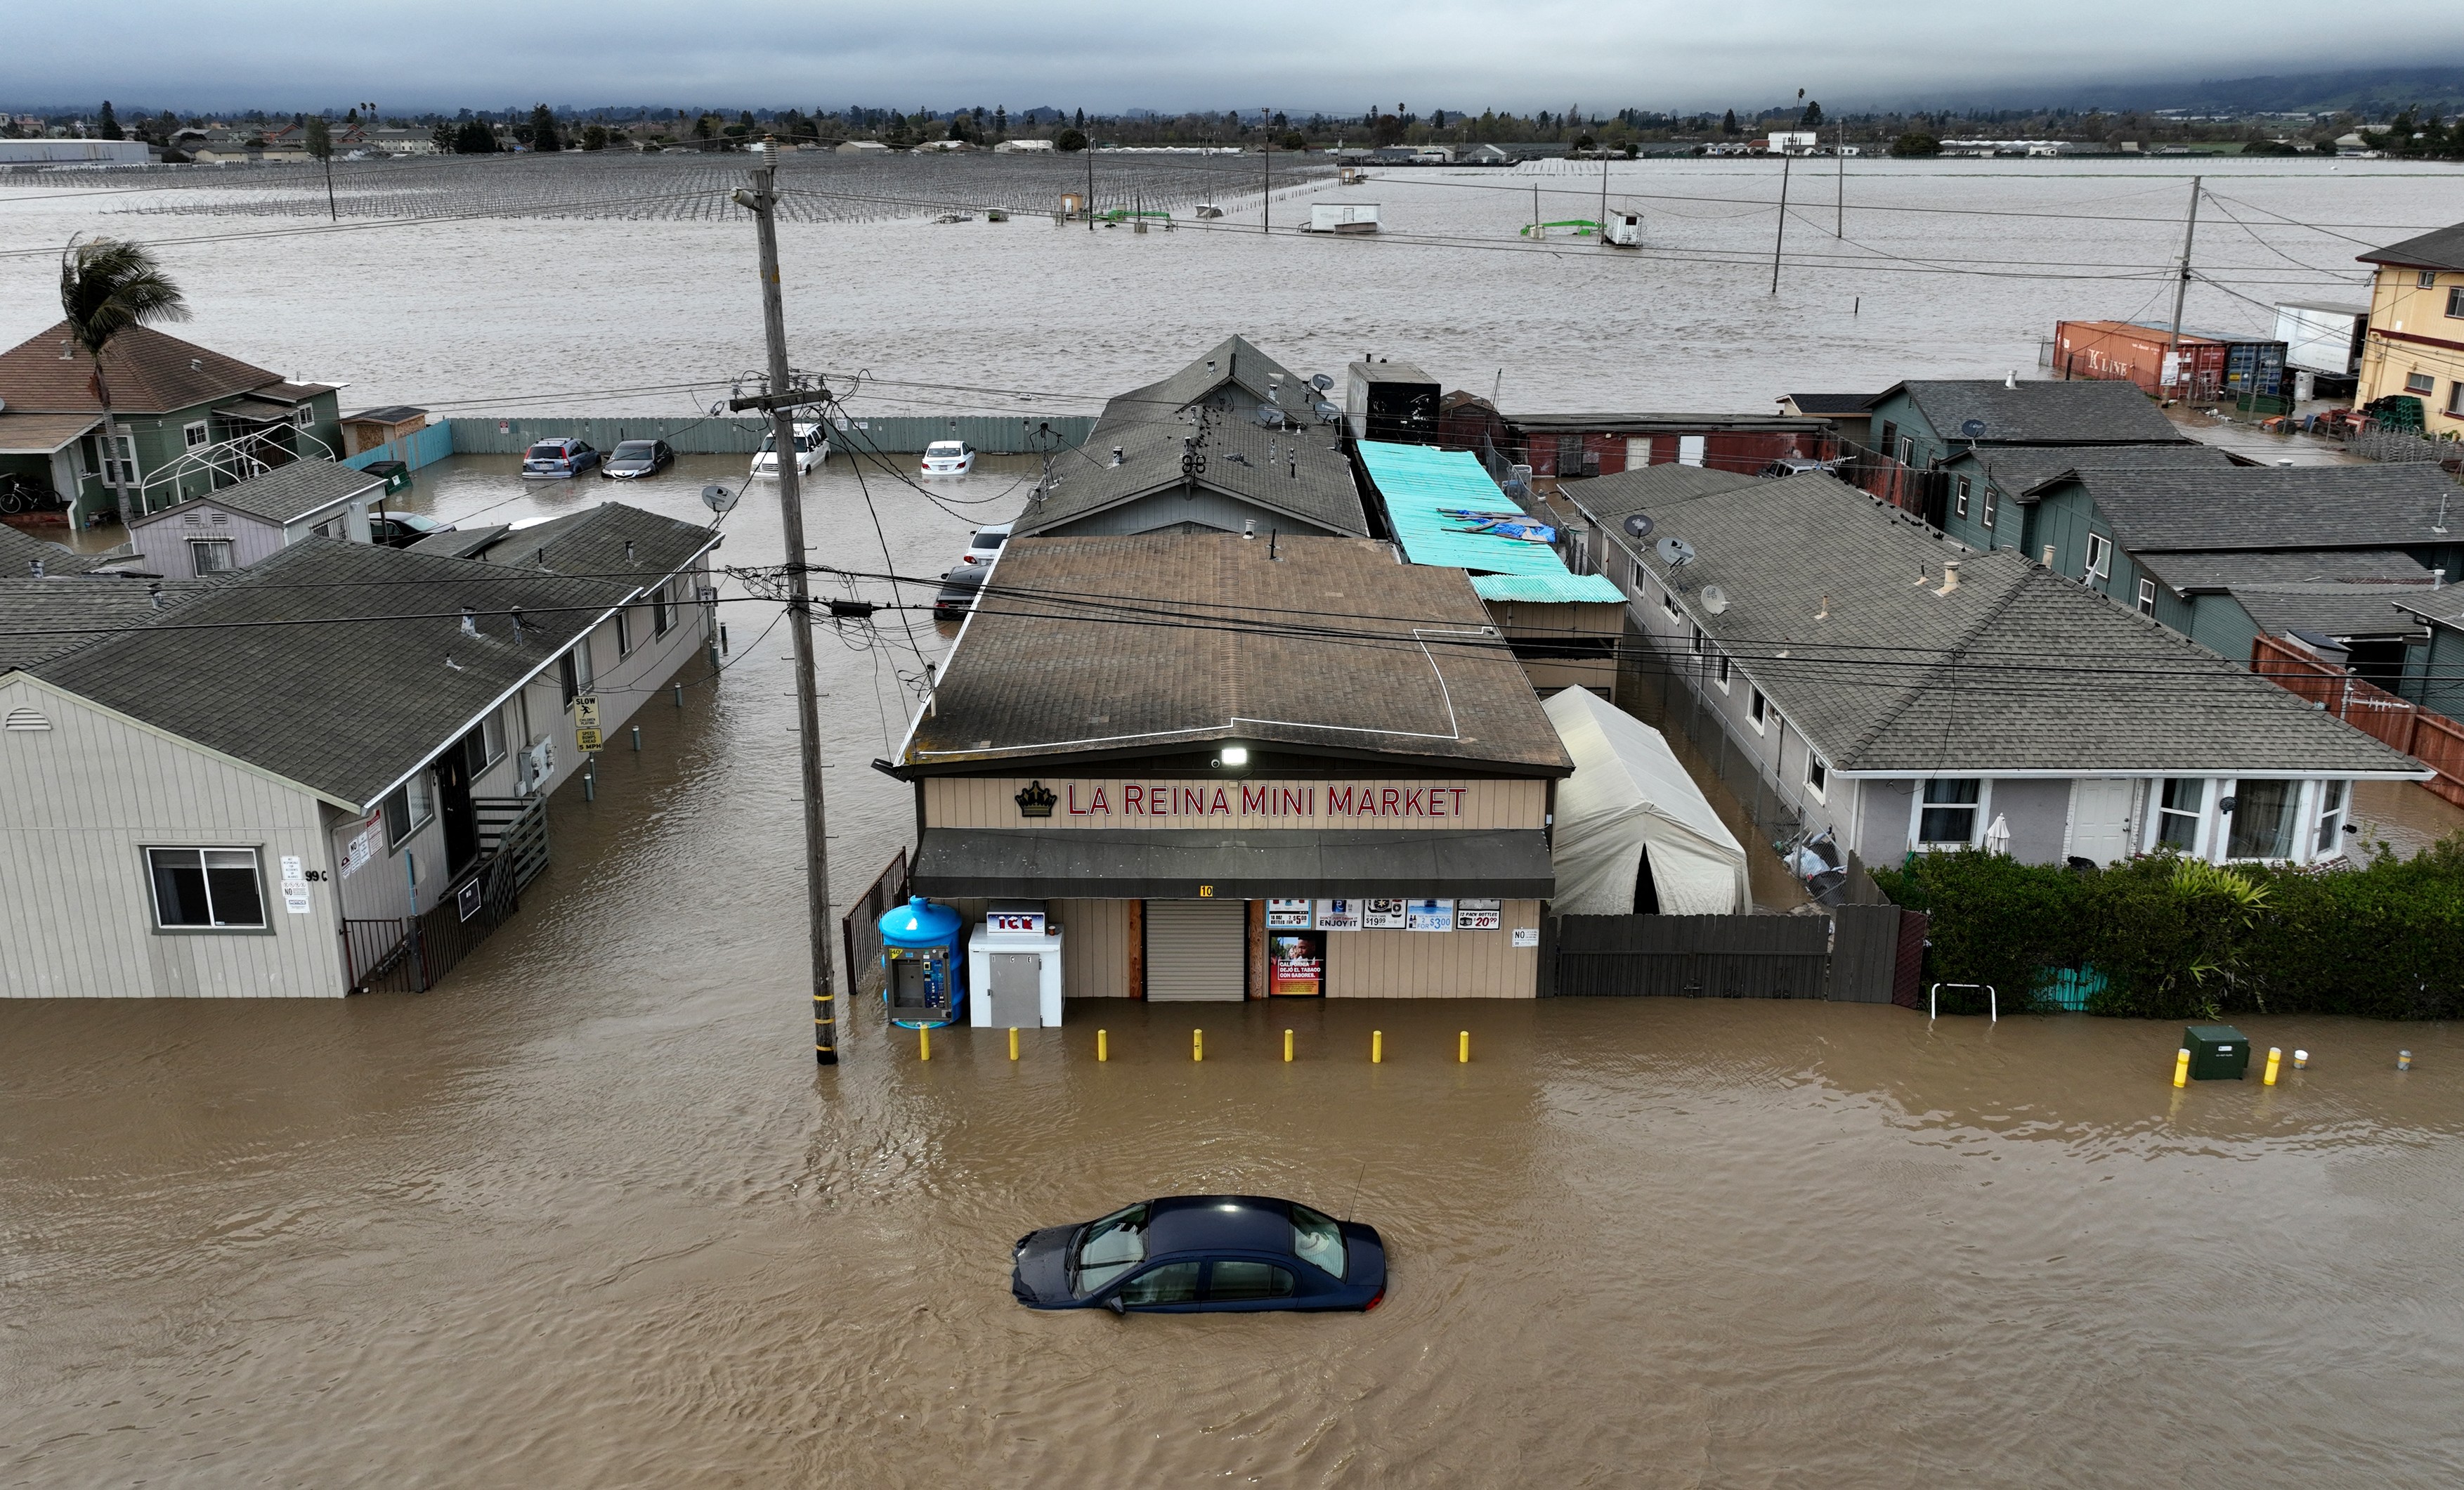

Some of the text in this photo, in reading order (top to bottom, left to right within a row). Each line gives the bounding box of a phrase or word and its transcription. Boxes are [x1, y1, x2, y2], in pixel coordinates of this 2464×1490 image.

[2088, 349, 2104, 370] K
[1067, 783, 1468, 817] LA REINA MINI MARKET
[350, 841, 357, 853] NO
[305, 870, 320, 882] 99
[1201, 886, 1212, 896] 10
[998, 915, 1033, 930] ICE
[1515, 931, 1525, 939] NO
